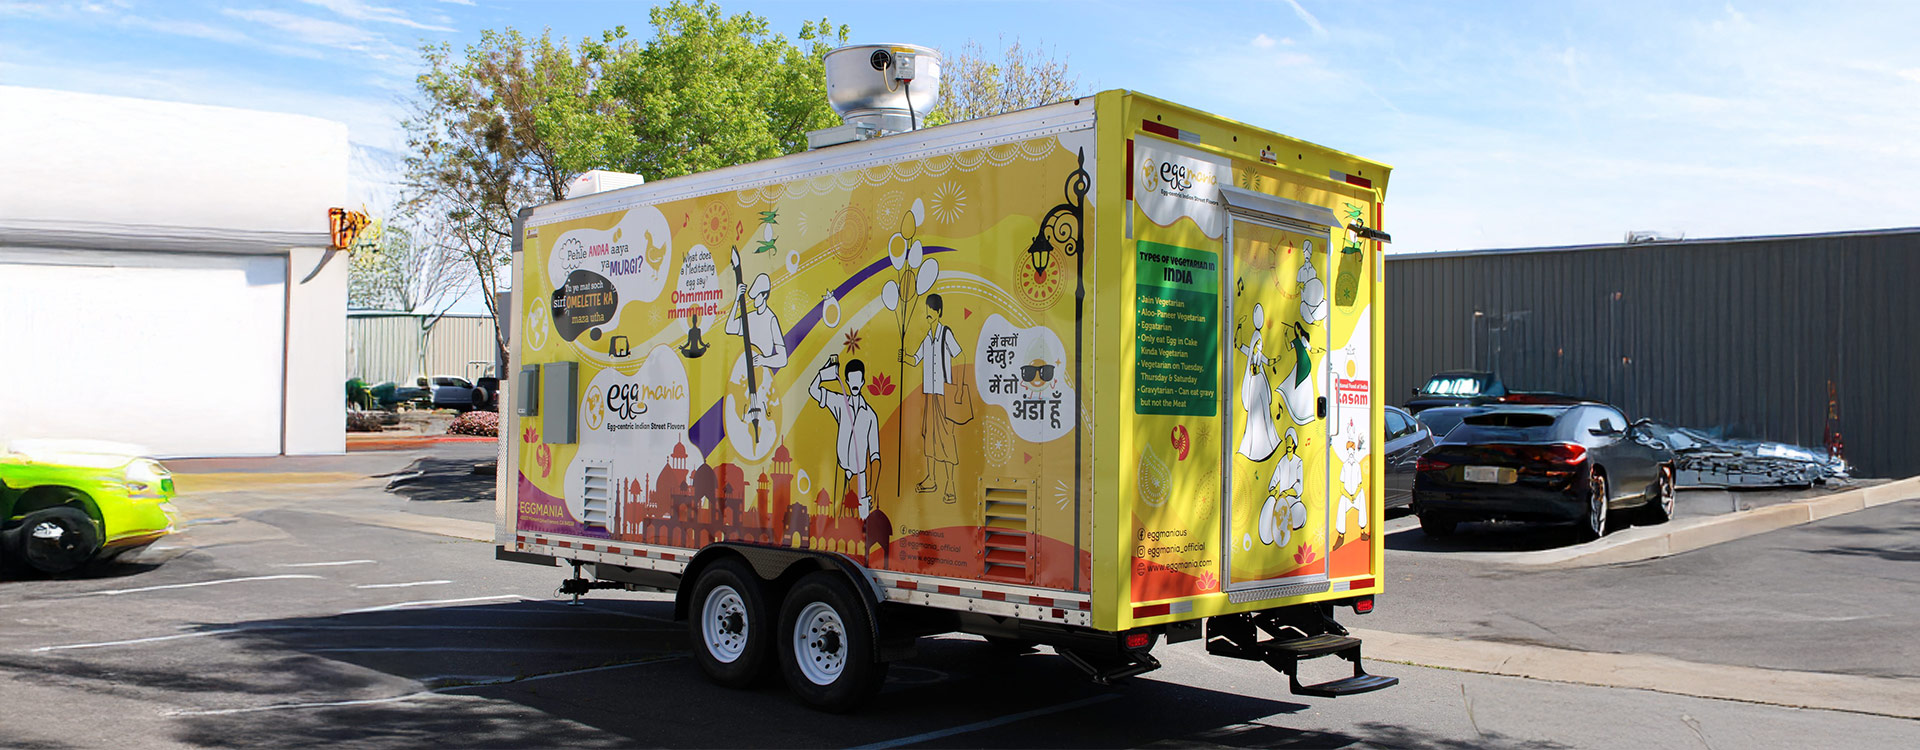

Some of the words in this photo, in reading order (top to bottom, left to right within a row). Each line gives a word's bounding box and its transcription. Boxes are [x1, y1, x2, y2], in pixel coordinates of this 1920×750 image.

[1160, 162, 1217, 191] eggmania
[1160, 188, 1182, 198] Egg-centric
[568, 249, 587, 260] Pehle
[588, 244, 609, 257] ANDAA
[610, 244, 628, 256] aaya
[682, 252, 698, 263] What
[699, 251, 711, 260] does
[601, 260, 609, 272] ya
[610, 255, 643, 276] MURGI?
[685, 263, 715, 275] Meditating
[1164, 268, 1192, 284] INDIA
[591, 280, 603, 289] soch
[686, 279, 695, 290] egg
[696, 276, 708, 288] say?
[553, 295, 566, 308] sirf
[566, 293, 601, 309] OMELETTE
[603, 292, 613, 305] KA
[671, 289, 723, 304] Ohmmmm
[1142, 296, 1154, 304] Jain
[1155, 297, 1184, 307] Vegetarian
[590, 312, 604, 322] utha
[1141, 309, 1176, 319] Aloo-Paneer
[1177, 312, 1206, 322] Vegetarian
[1000, 333, 1019, 347] क्यों
[1141, 334, 1155, 344] Only
[1166, 336, 1176, 346] Egg
[1184, 338, 1198, 346] Cake
[1141, 347, 1157, 355] Kinda
[1159, 348, 1188, 358] Vegetarian
[1141, 360, 1171, 369] Vegetarian
[1003, 374, 1019, 394] तो
[1141, 372, 1168, 383] Thursday
[1174, 375, 1197, 384] Saturday
[1141, 385, 1173, 395] Gravytarian
[1178, 387, 1189, 395] Can
[607, 381, 685, 420] eggmania
[1013, 394, 1046, 420] अंडा
[1049, 391, 1062, 428] हूँ
[607, 423, 634, 431] Egg-centric
[520, 502, 564, 518] EGGMANIA
[1147, 542, 1206, 558] eggmania_official
[908, 555, 968, 567] www.eggmania.com
[1147, 559, 1212, 573] www.eggmania.com
